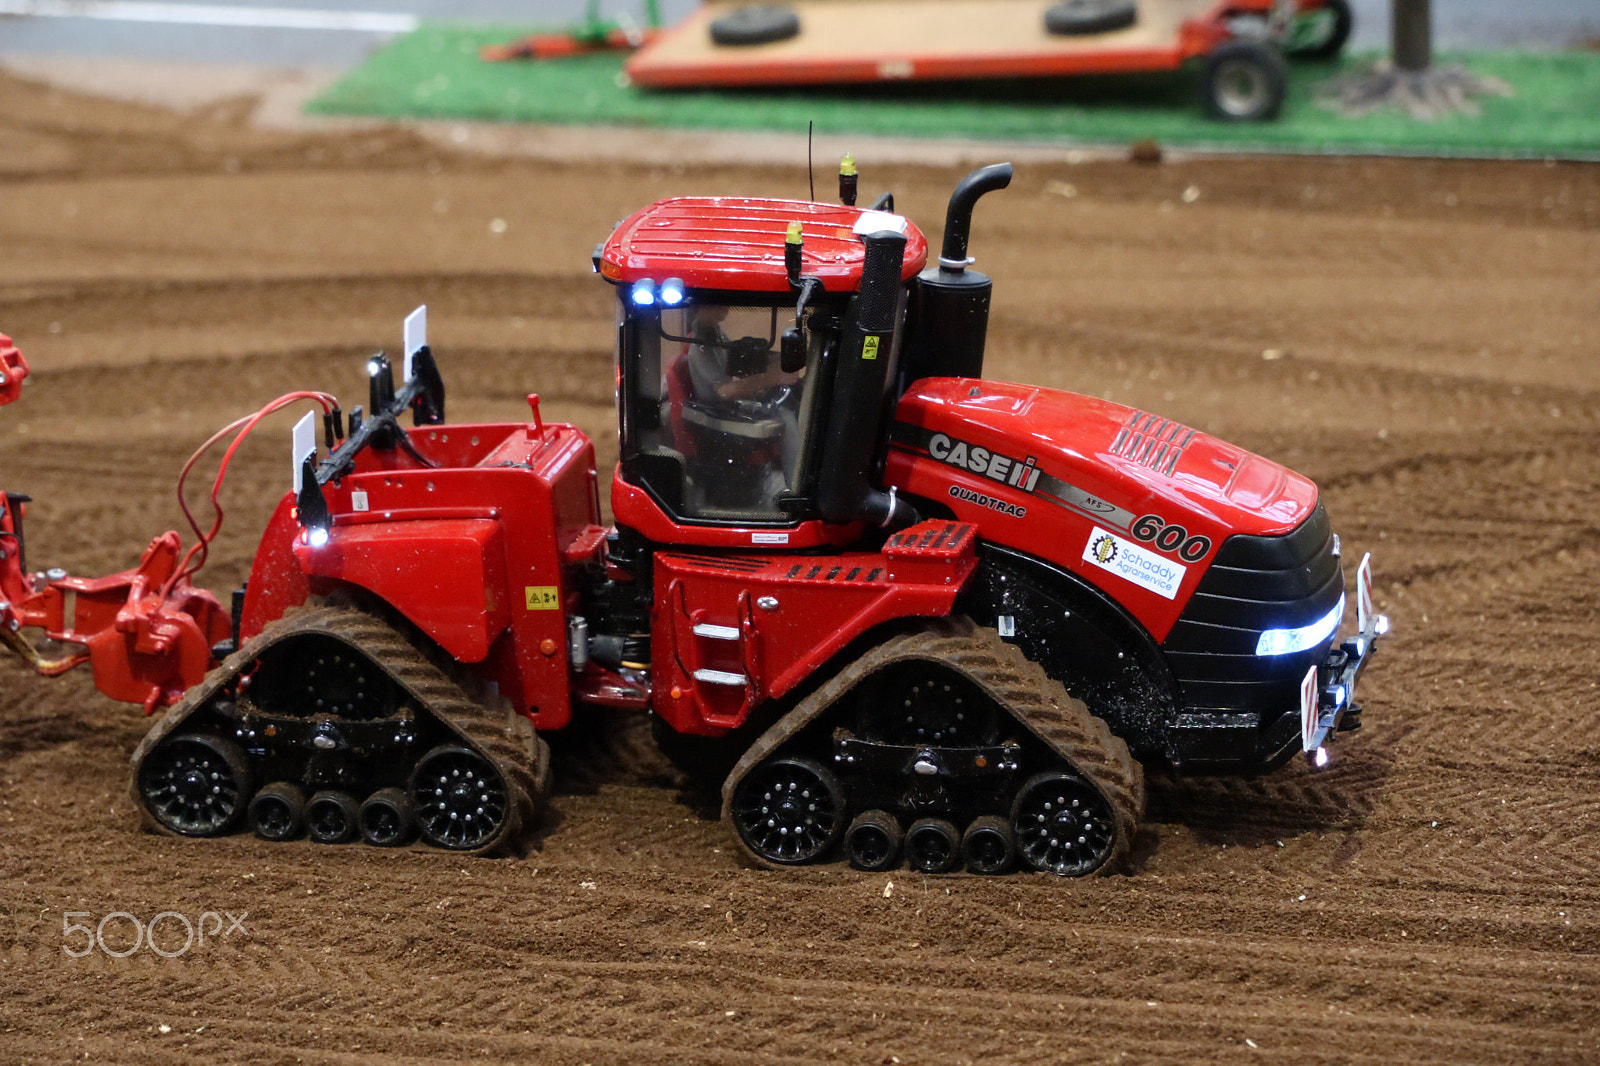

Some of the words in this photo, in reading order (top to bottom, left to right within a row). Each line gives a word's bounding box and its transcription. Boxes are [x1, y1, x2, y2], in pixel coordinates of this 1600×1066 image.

[948, 485, 1027, 518] QUADTRAC
[1085, 497, 1102, 509] AFS
[1131, 513, 1212, 563] 600
[1115, 560, 1173, 591] Agrarservice
[1121, 548, 1176, 581] Schaddy
